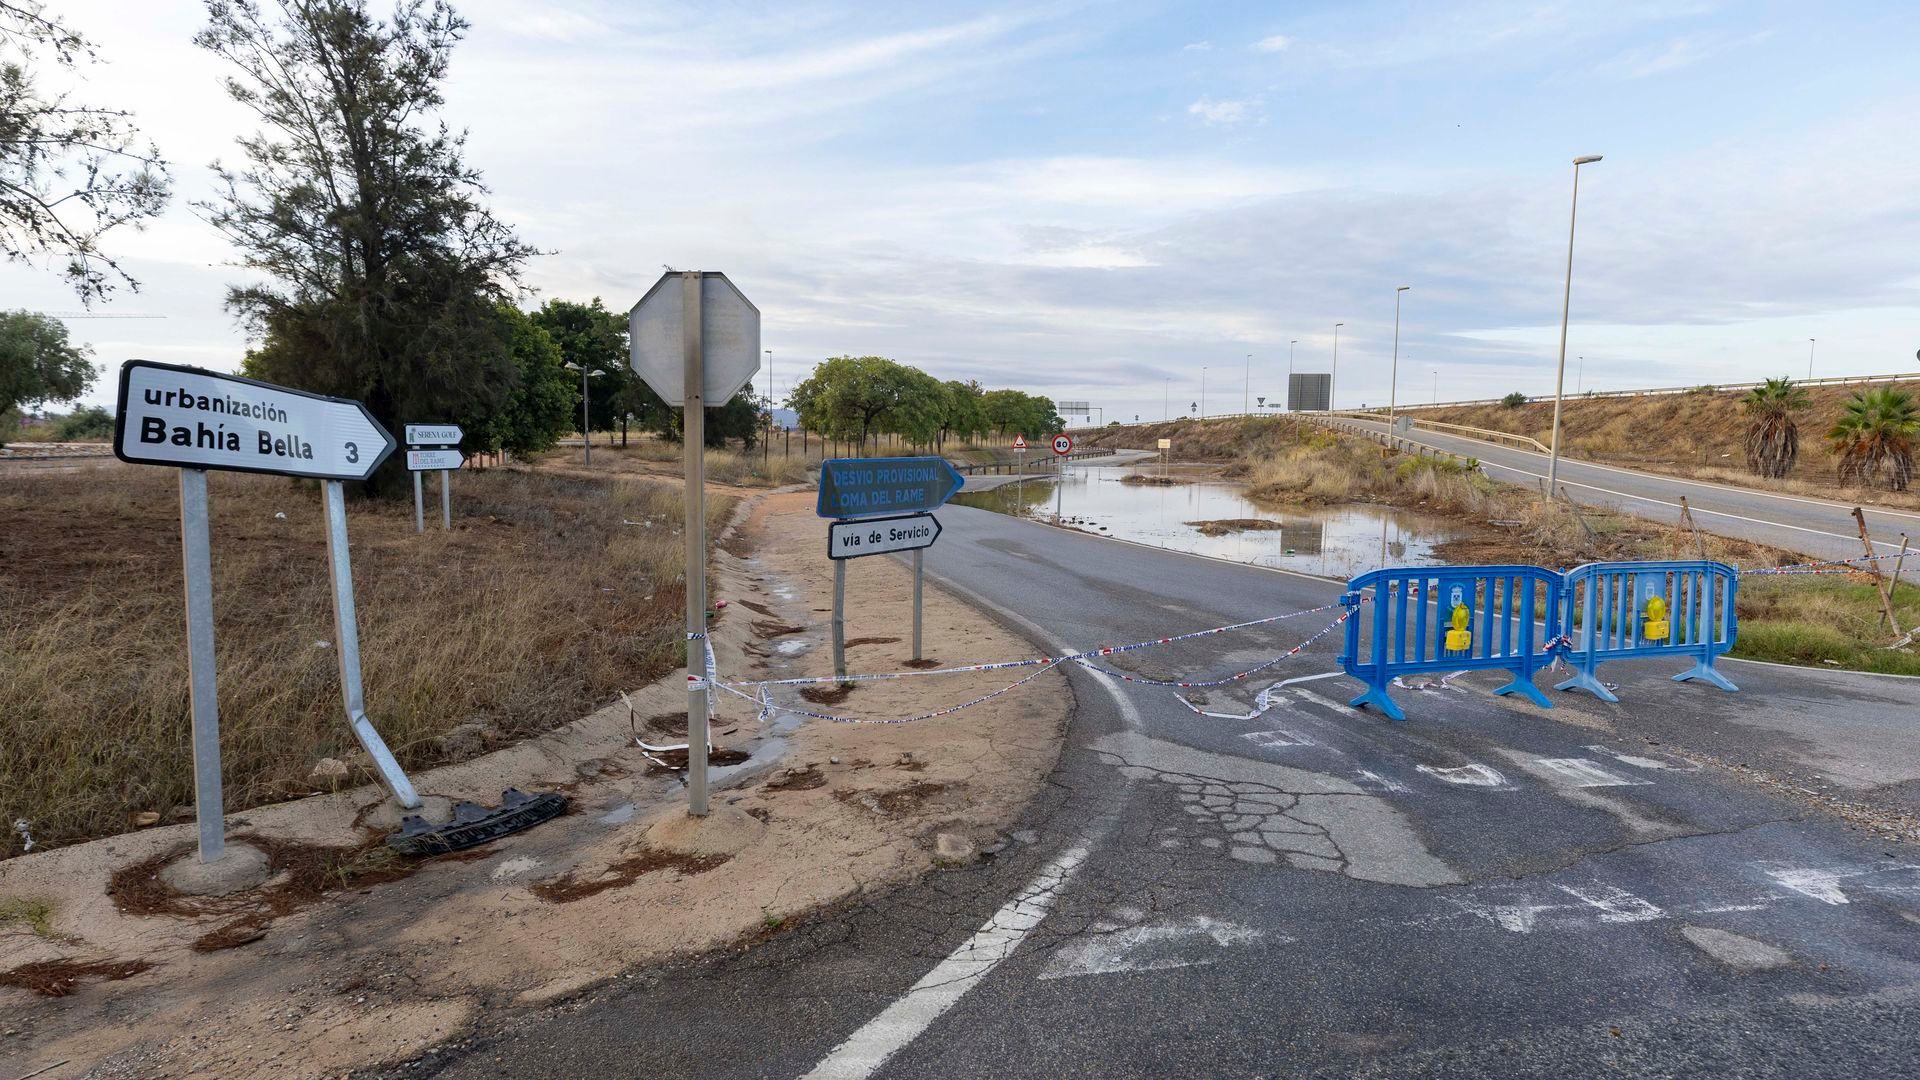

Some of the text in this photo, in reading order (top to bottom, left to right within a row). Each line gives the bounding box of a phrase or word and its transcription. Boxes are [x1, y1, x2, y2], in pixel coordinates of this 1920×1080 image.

[144, 387, 288, 424] urbanización
[140, 416, 313, 461] Bahía Bella
[344, 441, 360, 464] 3
[833, 466, 939, 487] DESVIO PROVISIONAL
[871, 490, 891, 505] DEL
[895, 488, 925, 503] RAME
[869, 531, 882, 544] de
[889, 525, 930, 541] Servicio
